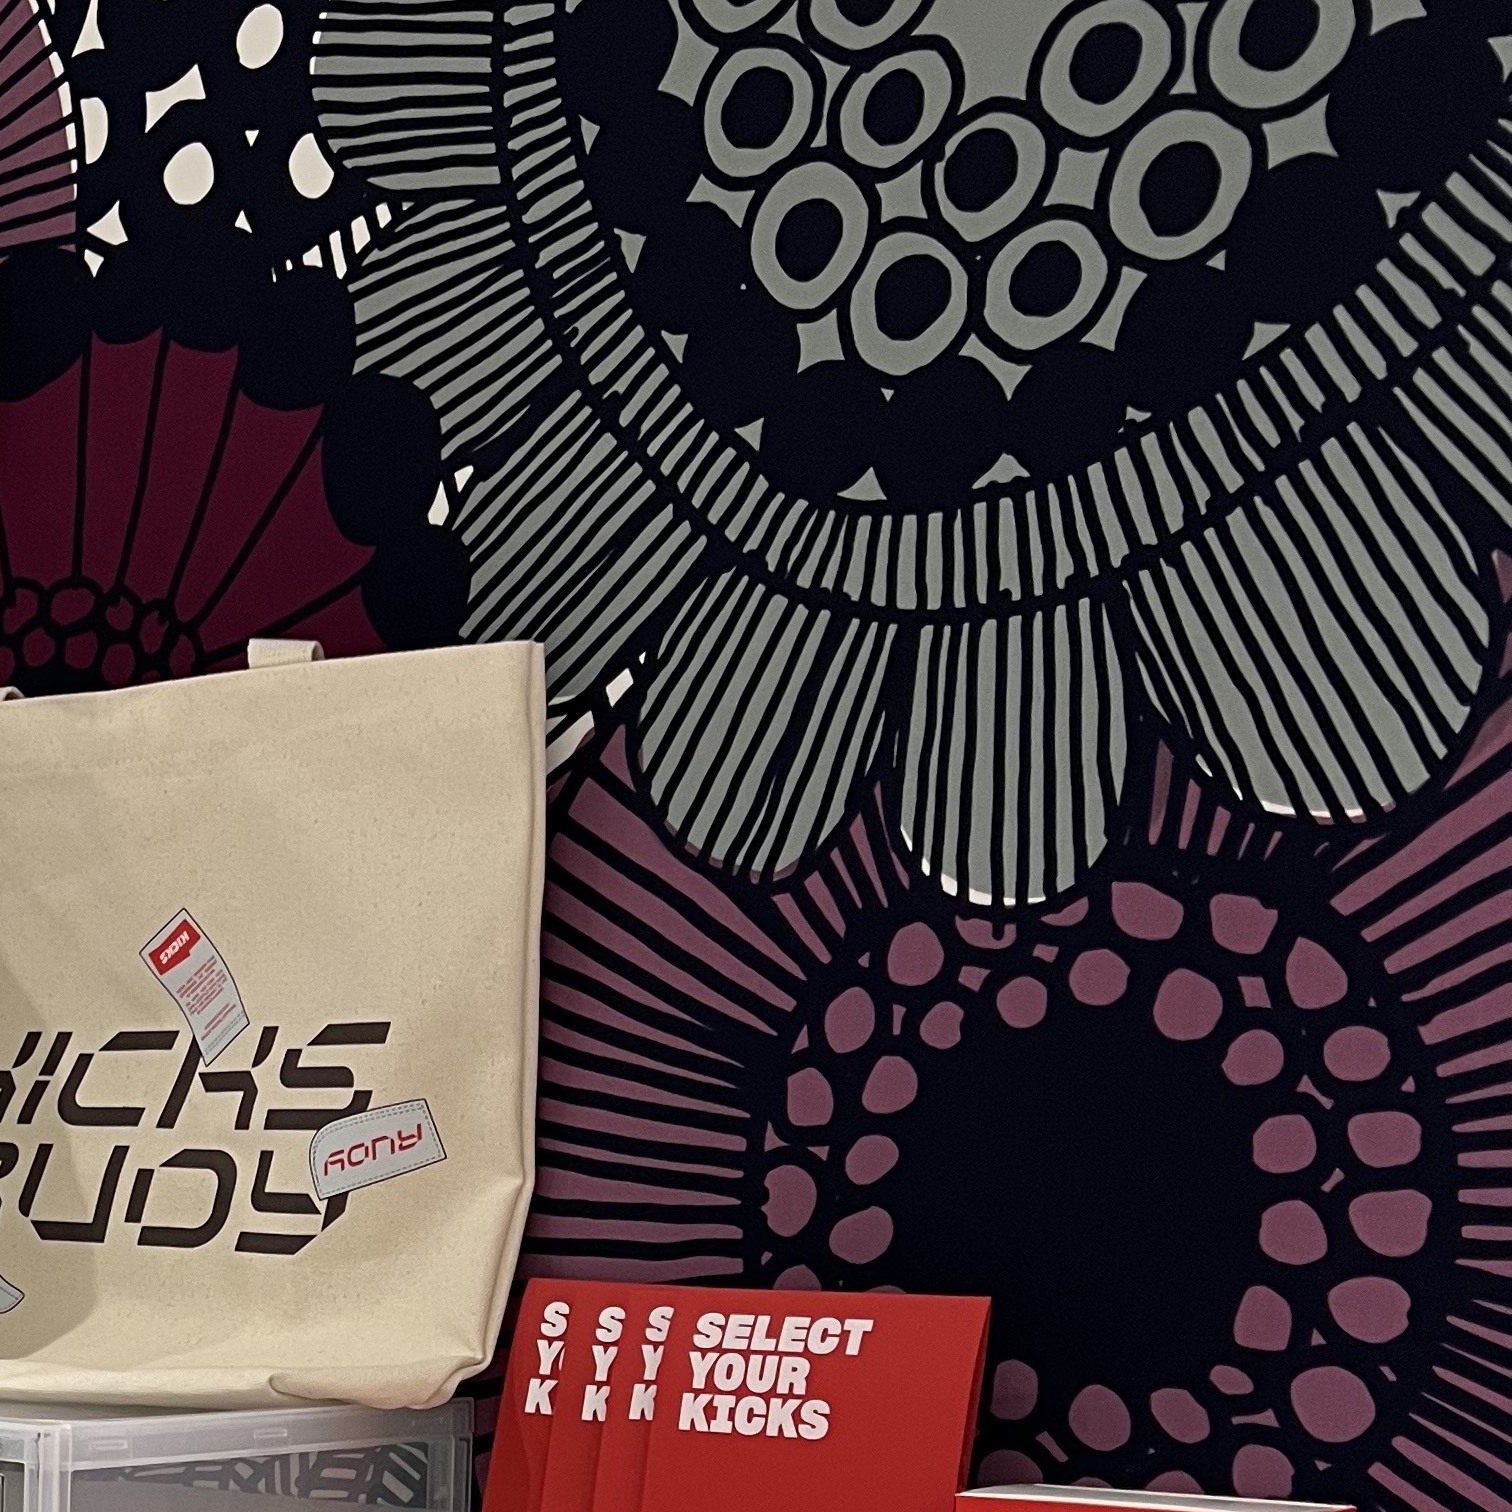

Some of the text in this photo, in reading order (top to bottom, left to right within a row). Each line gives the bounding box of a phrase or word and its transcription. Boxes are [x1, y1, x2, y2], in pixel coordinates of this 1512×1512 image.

[324, 1123, 422, 1177] RUDY
[693, 1312, 873, 1355] SELECT
[688, 1351, 811, 1394] YOUR
[678, 1393, 831, 1440] KICKS
